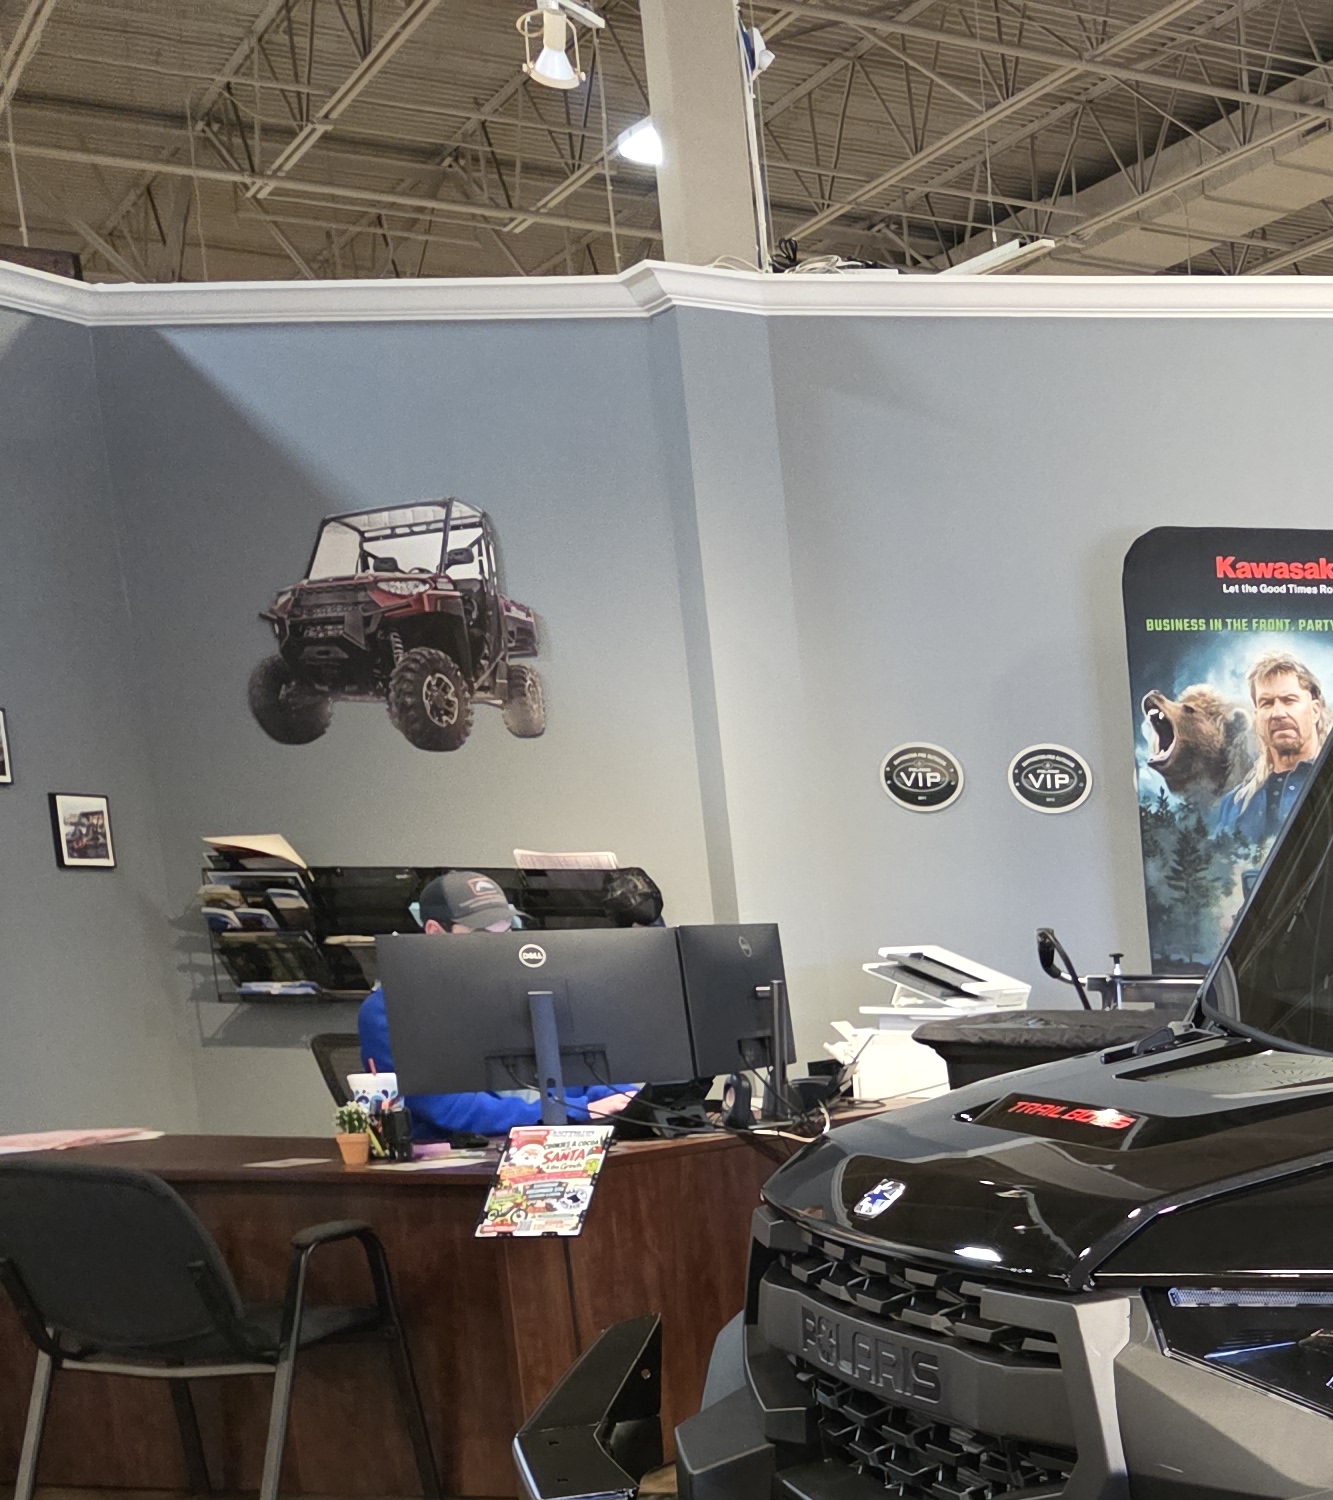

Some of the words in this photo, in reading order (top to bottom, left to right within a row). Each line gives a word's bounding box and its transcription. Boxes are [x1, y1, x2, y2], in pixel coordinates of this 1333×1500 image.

[1223, 584, 1239, 594] Let
[1242, 584, 1258, 594] the
[1259, 584, 1286, 594] Good
[1288, 585, 1318, 595] Times
[1146, 619, 1206, 631] BUSINESS
[1209, 618, 1222, 631] IN
[1226, 619, 1248, 631] THE
[1252, 619, 1295, 631] FRONT.
[900, 771, 941, 787] VIP
[1028, 773, 1069, 789] VIP
[1007, 1101, 1068, 1119] TRAIL
[1061, 1108, 1137, 1129] BOS
[541, 1149, 586, 1165] SANTA
[801, 1306, 941, 1403] POLARIS
